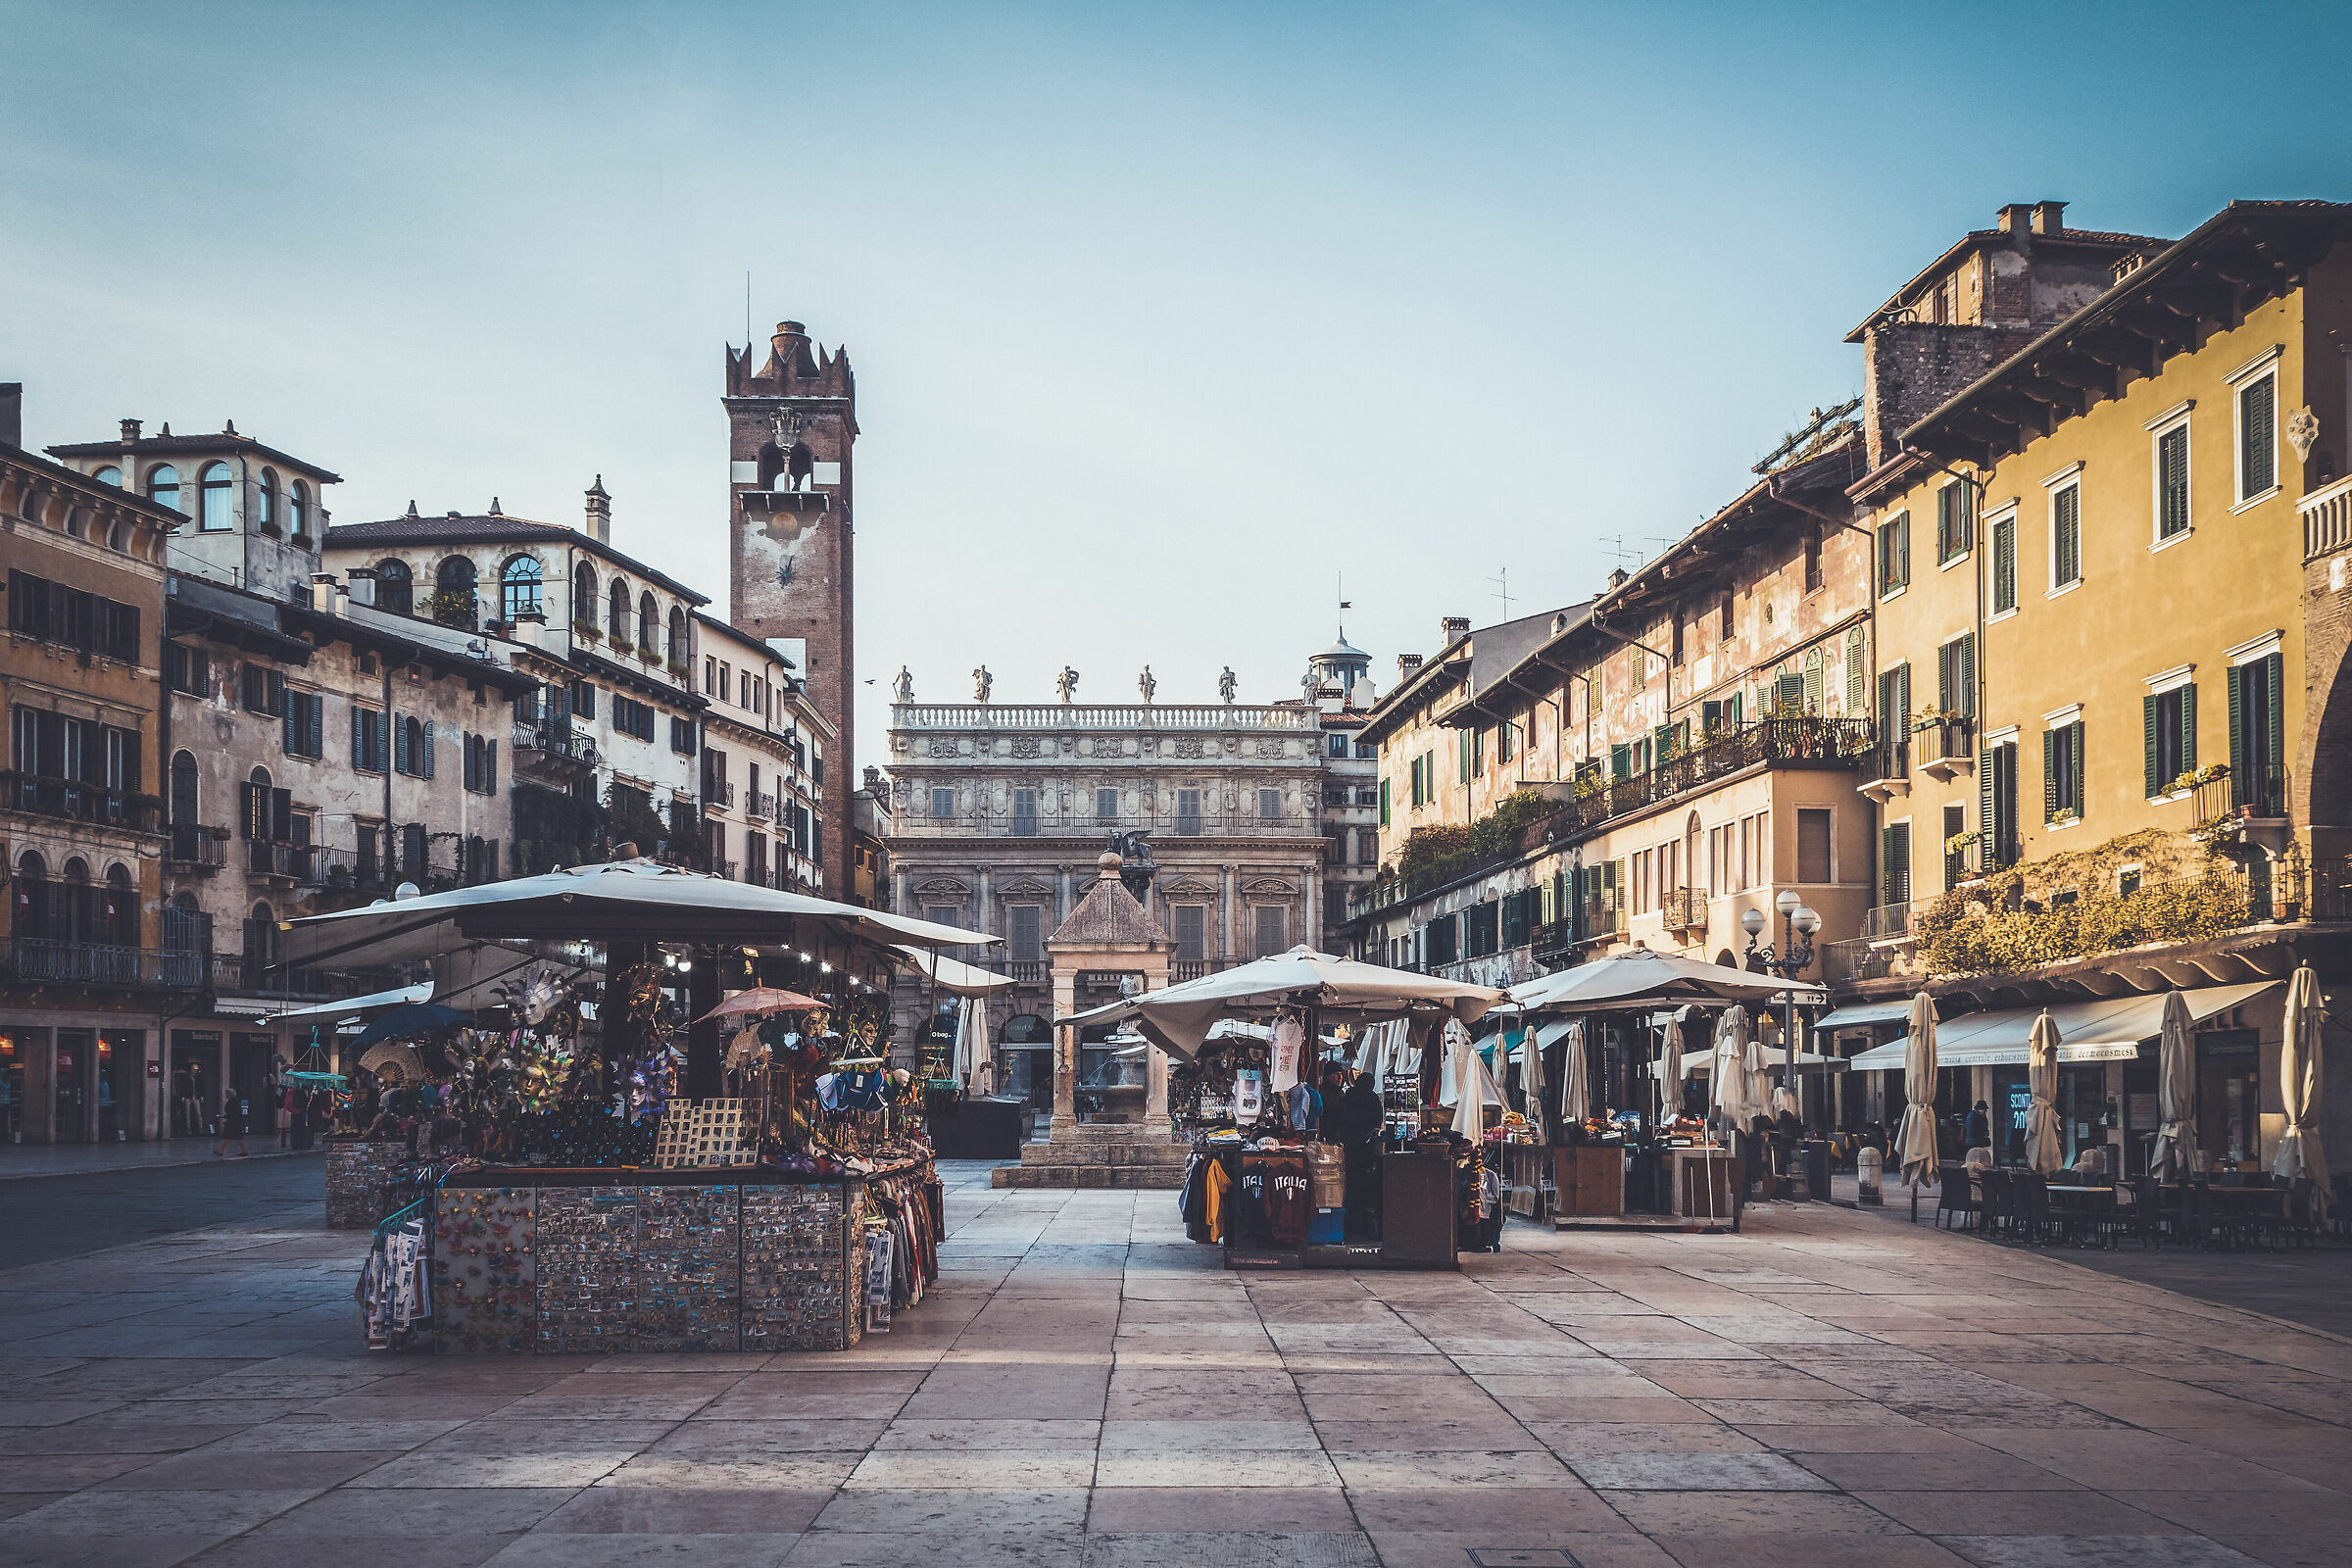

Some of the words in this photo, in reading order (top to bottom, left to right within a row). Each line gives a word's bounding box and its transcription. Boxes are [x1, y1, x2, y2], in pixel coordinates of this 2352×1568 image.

[2013, 1110, 2027, 1129] 20
[1243, 1176, 1263, 1189] ITAL
[1275, 1176, 1307, 1191] ITALIA
